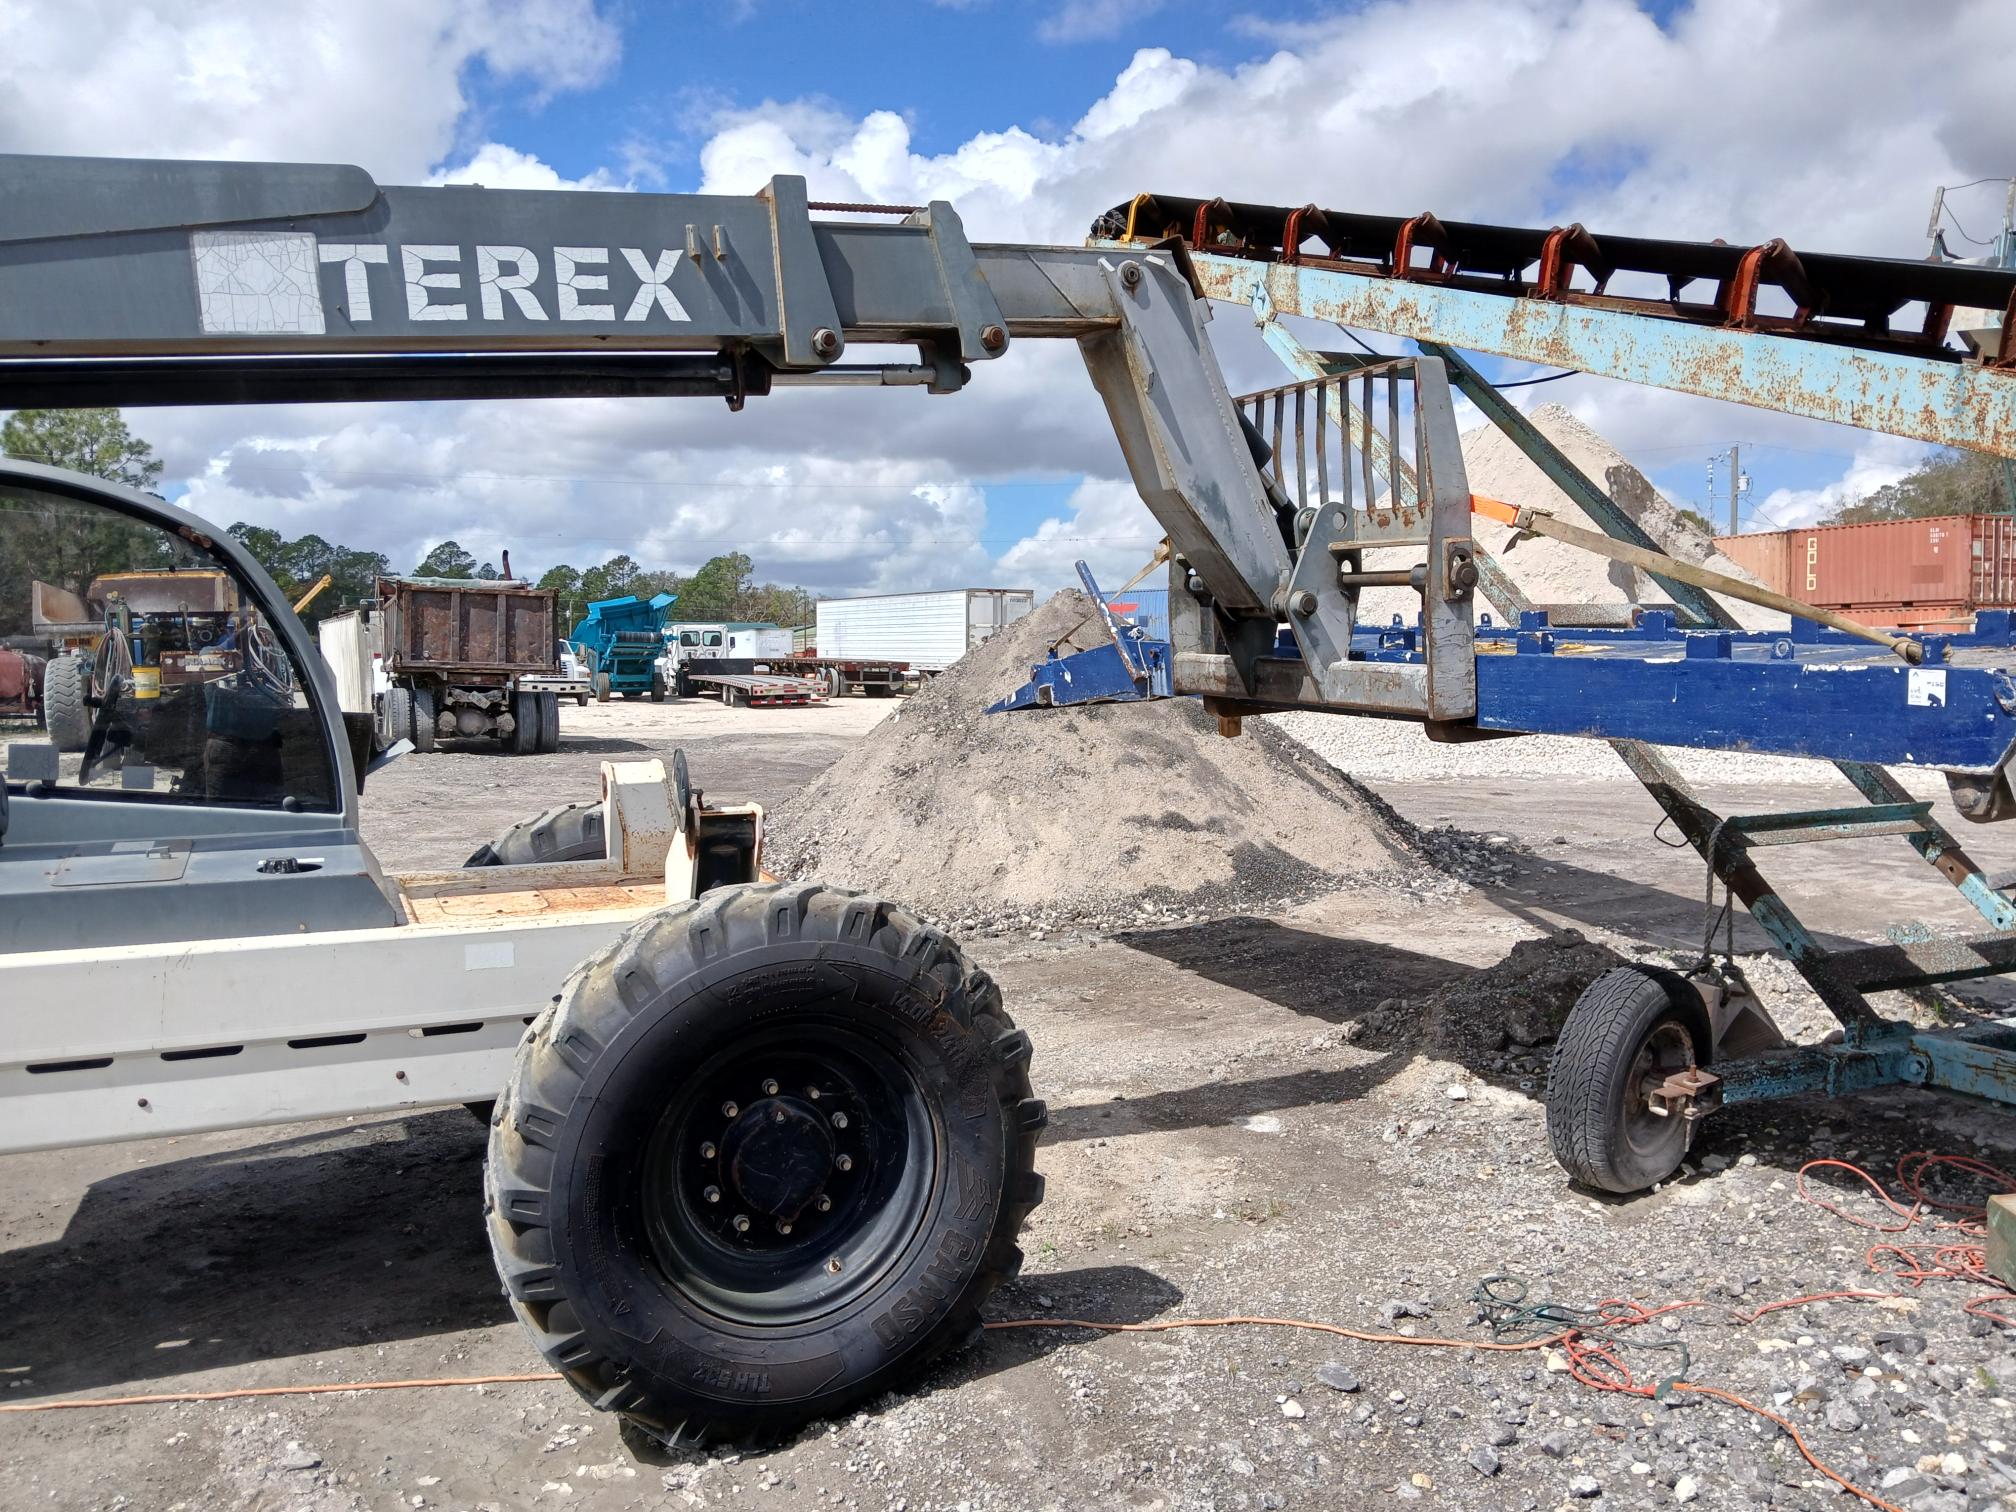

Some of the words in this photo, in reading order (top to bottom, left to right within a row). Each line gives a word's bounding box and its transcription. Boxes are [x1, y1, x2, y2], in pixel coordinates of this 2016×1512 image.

[319, 244, 692, 322] TEREX
[1806, 537, 1818, 591] GOLD
[870, 1229, 977, 1350] CAMSO
